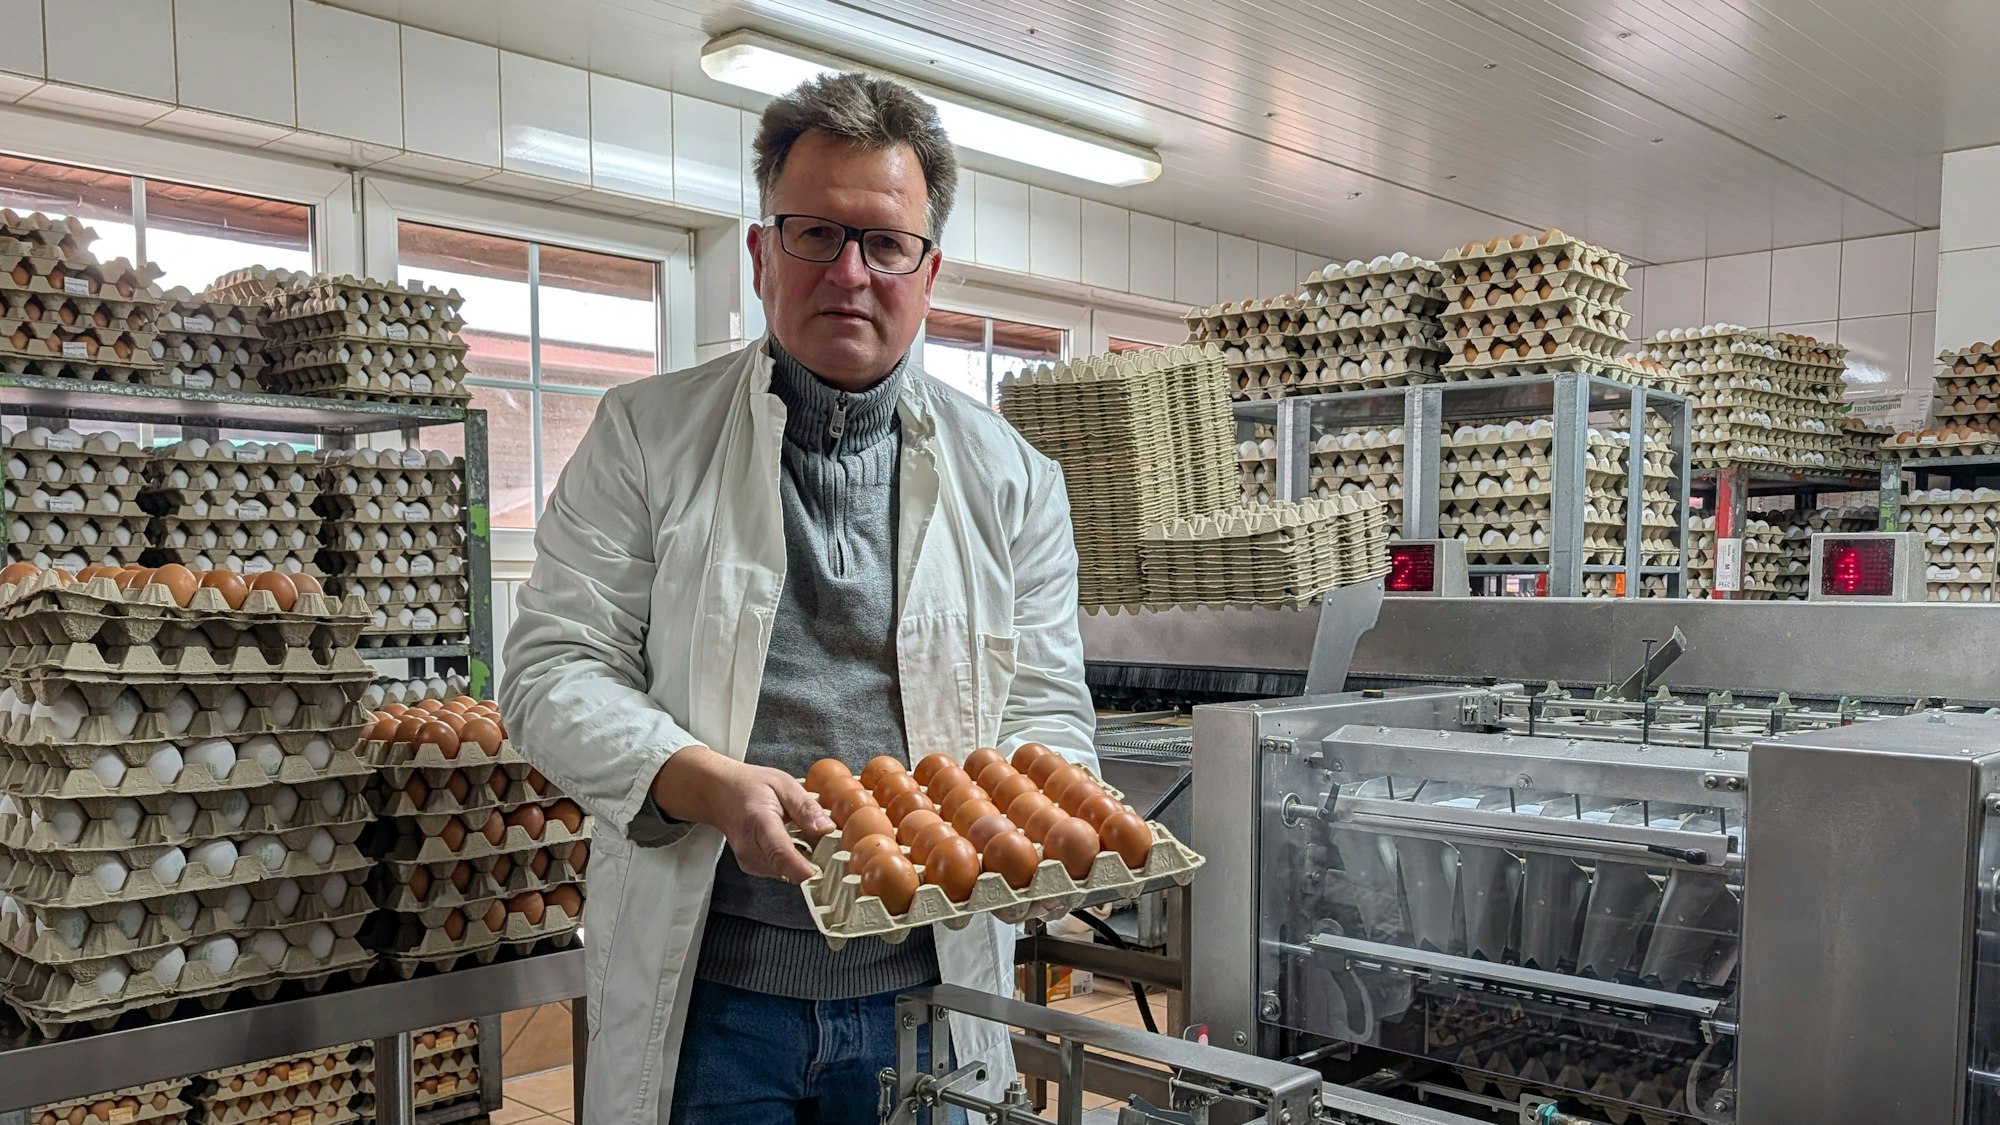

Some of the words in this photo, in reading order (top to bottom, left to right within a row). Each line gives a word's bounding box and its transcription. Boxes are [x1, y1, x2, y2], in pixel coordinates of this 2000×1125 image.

[1392, 556, 1412, 587] 2
[1838, 552, 1859, 591] 4
[861, 906, 879, 927] L
[922, 899, 938, 916] E
[985, 884, 1002, 903] O
[1158, 852, 1176, 868] M
